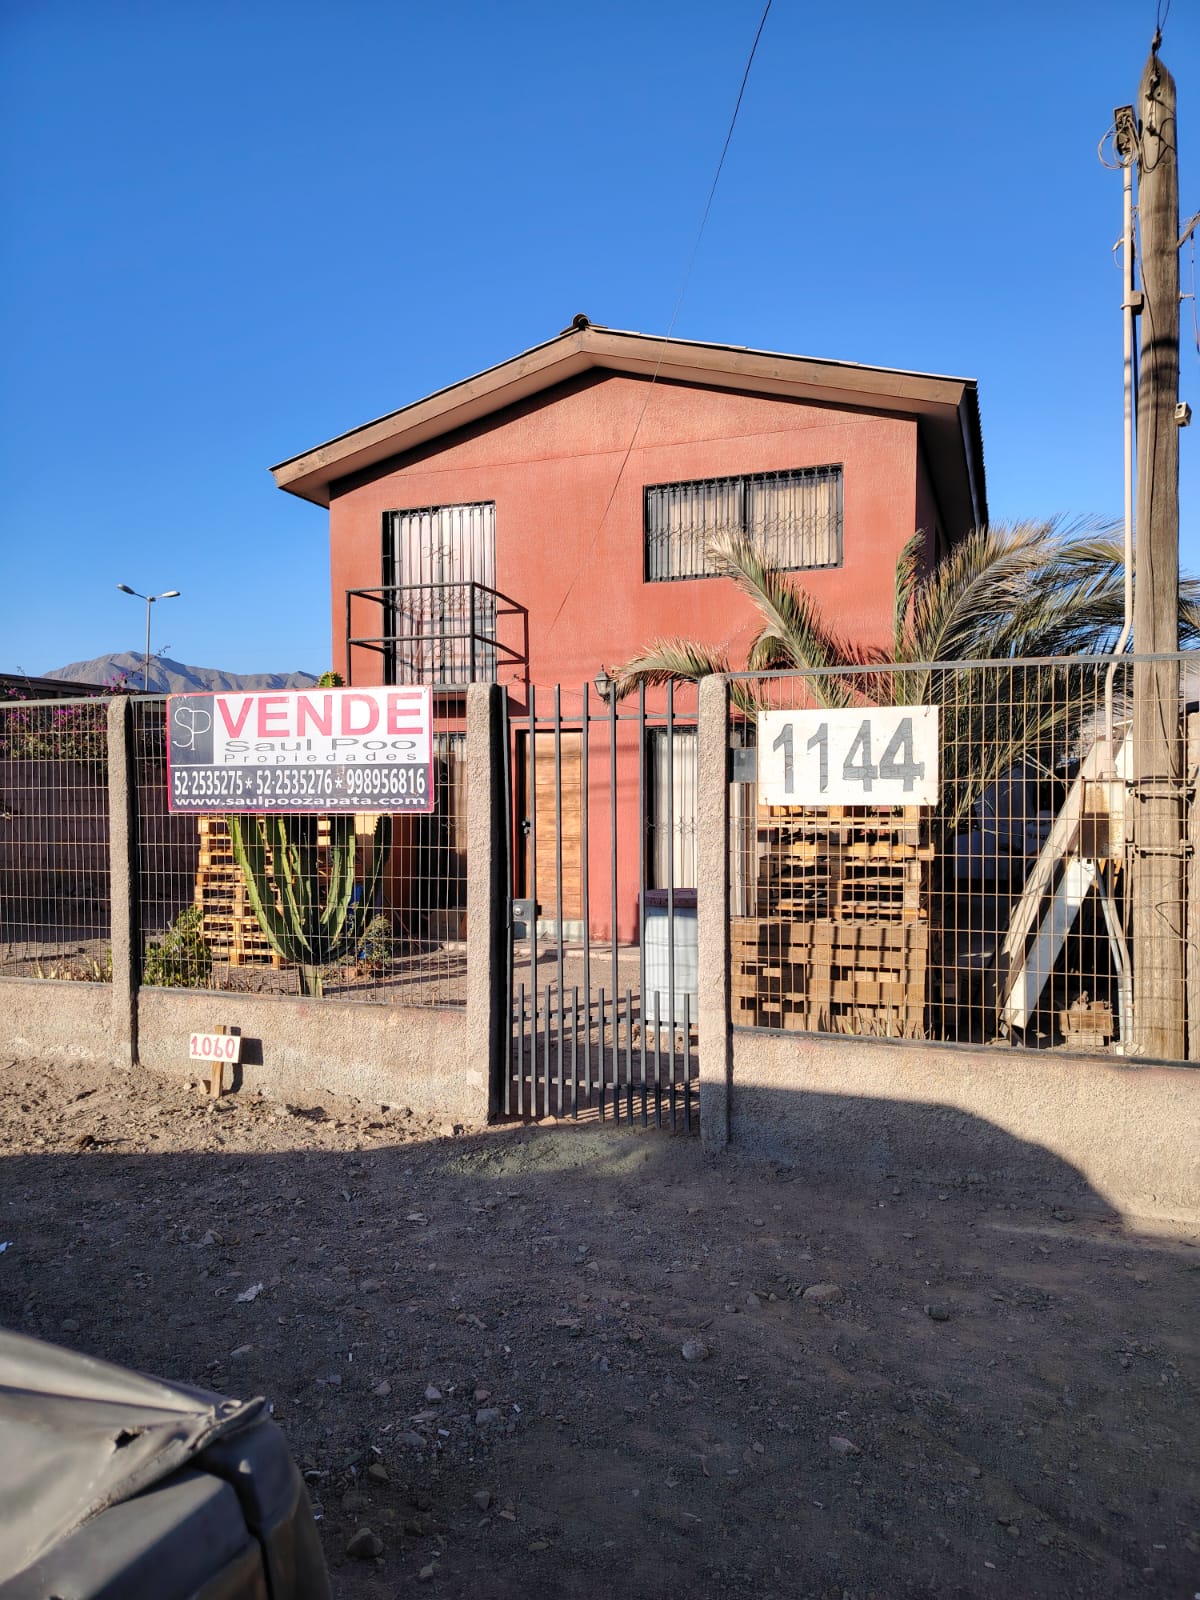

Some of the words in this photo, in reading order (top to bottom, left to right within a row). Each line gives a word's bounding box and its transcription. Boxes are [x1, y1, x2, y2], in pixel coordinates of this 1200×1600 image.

[216, 692, 424, 738] VENDE
[224, 738, 312, 753] Saul
[331, 737, 417, 751] Poo
[772, 717, 926, 794] 1144
[224, 751, 417, 765] Propiedades
[346, 767, 426, 795] 998956816
[175, 795, 426, 808] www.saulpoozapata.com
